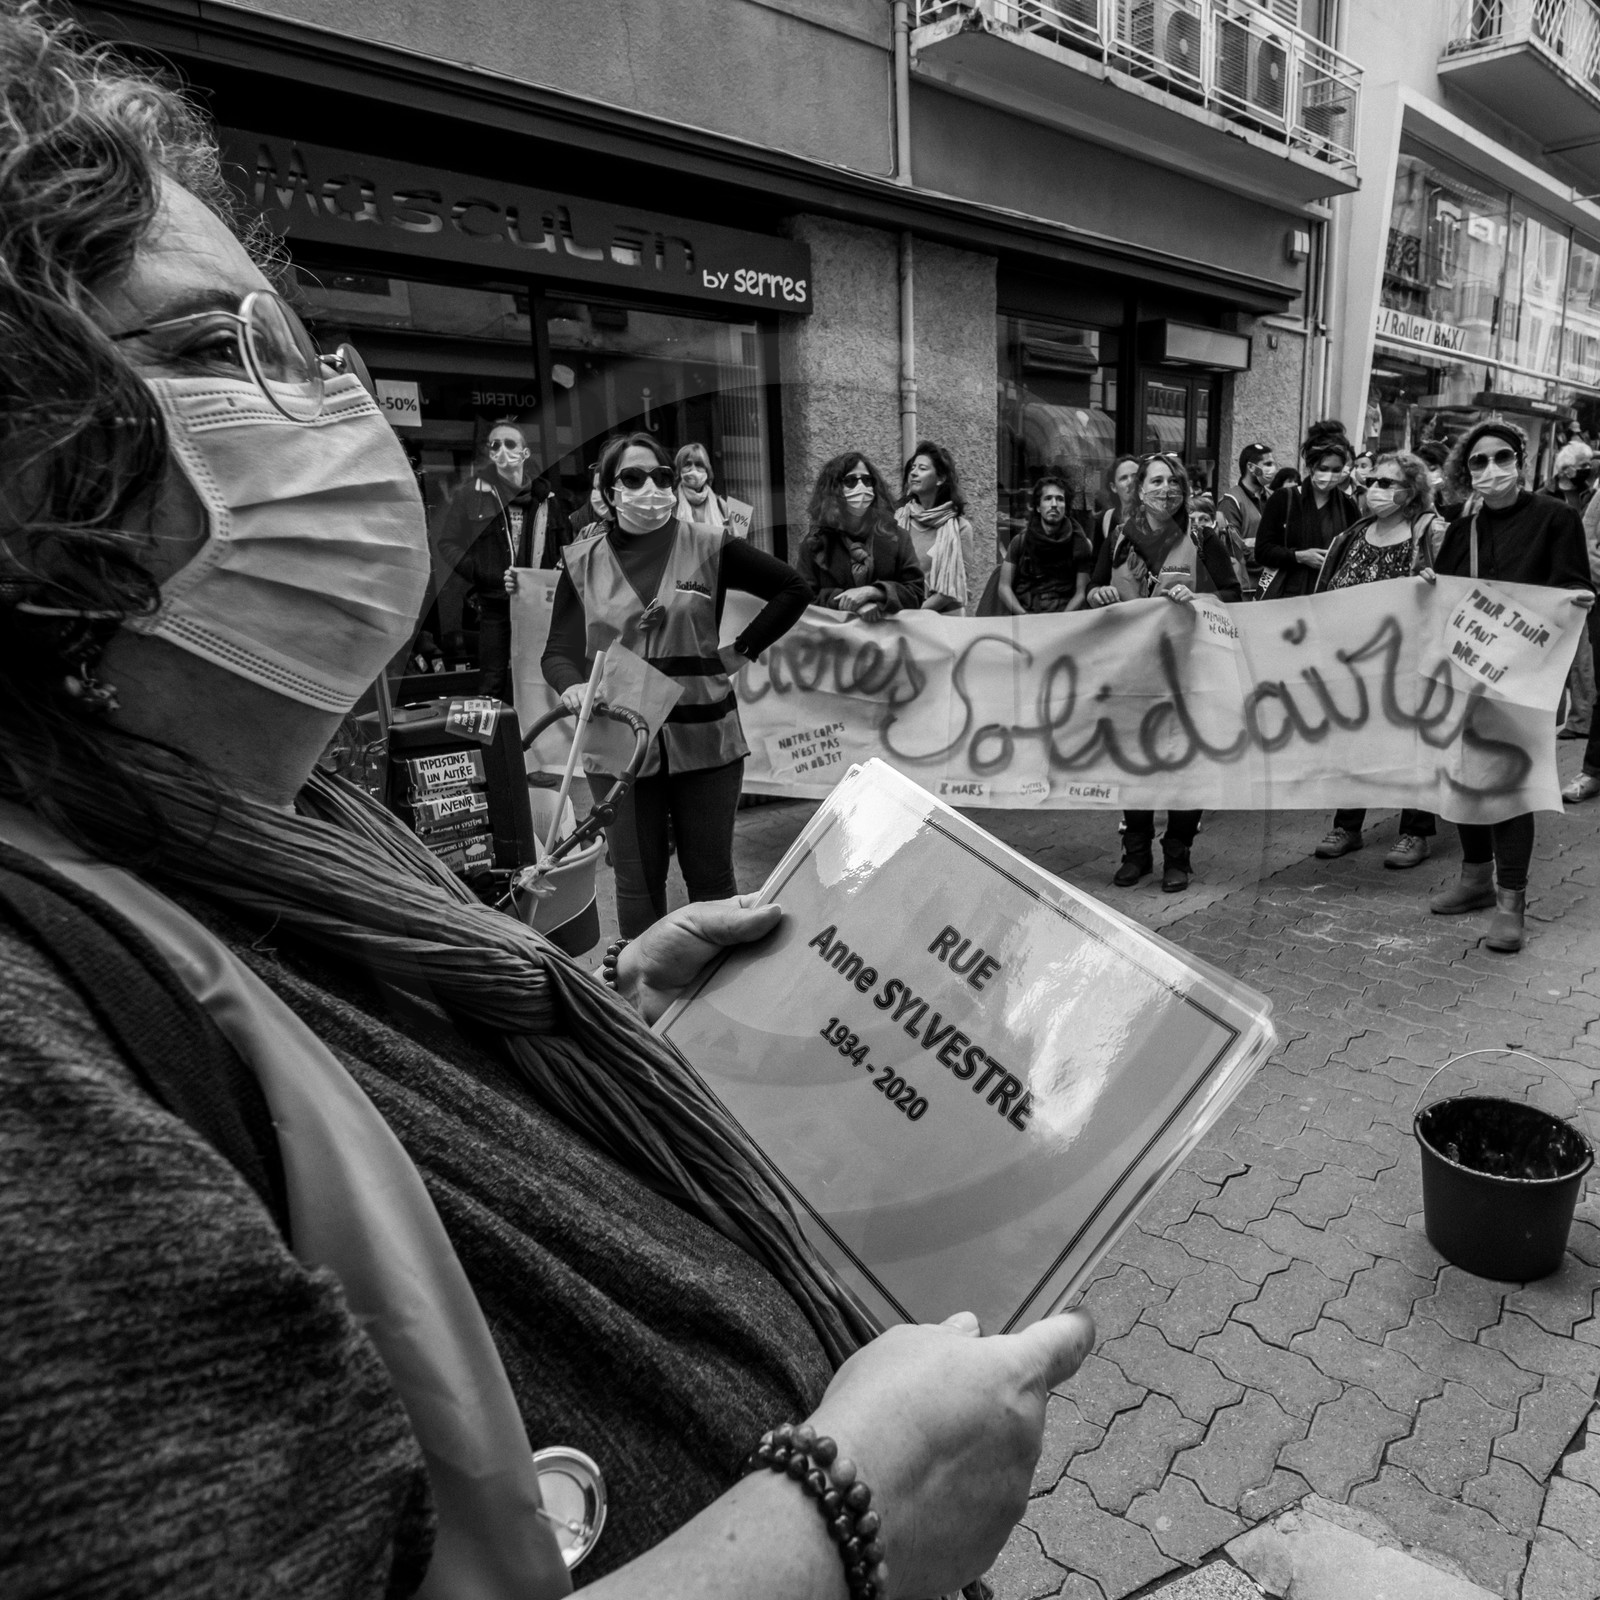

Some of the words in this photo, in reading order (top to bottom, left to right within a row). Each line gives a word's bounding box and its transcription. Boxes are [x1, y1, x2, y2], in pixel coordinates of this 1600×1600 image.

[703, 269, 729, 289] by
[734, 268, 806, 302] serres
[1391, 313, 1425, 343] Roller
[379, 396, 417, 412] -50%
[1466, 589, 1506, 620] POUR
[1503, 611, 1550, 648] JOUIR
[1465, 620, 1498, 646] FAUT
[1452, 640, 1480, 667] DIRE
[1479, 661, 1509, 683] OUI
[879, 615, 1533, 798] Solidaires
[778, 732, 811, 749] NOTRE
[813, 722, 845, 736] CORPS
[820, 737, 840, 752] PAS
[420, 754, 466, 771] IMPOSONS
[427, 773, 440, 783] UN
[444, 765, 473, 780] AUTRE
[795, 762, 809, 773] UN
[811, 751, 842, 769] OBJET
[952, 784, 983, 796] MARS
[1069, 786, 1080, 795] EN
[441, 796, 474, 813] AVENIR
[927, 924, 1002, 992] RUE
[808, 924, 878, 994] Anne
[873, 978, 1036, 1132] SYLVESTRE
[820, 1017, 870, 1068] 1934
[872, 1065, 929, 1122] 2020
